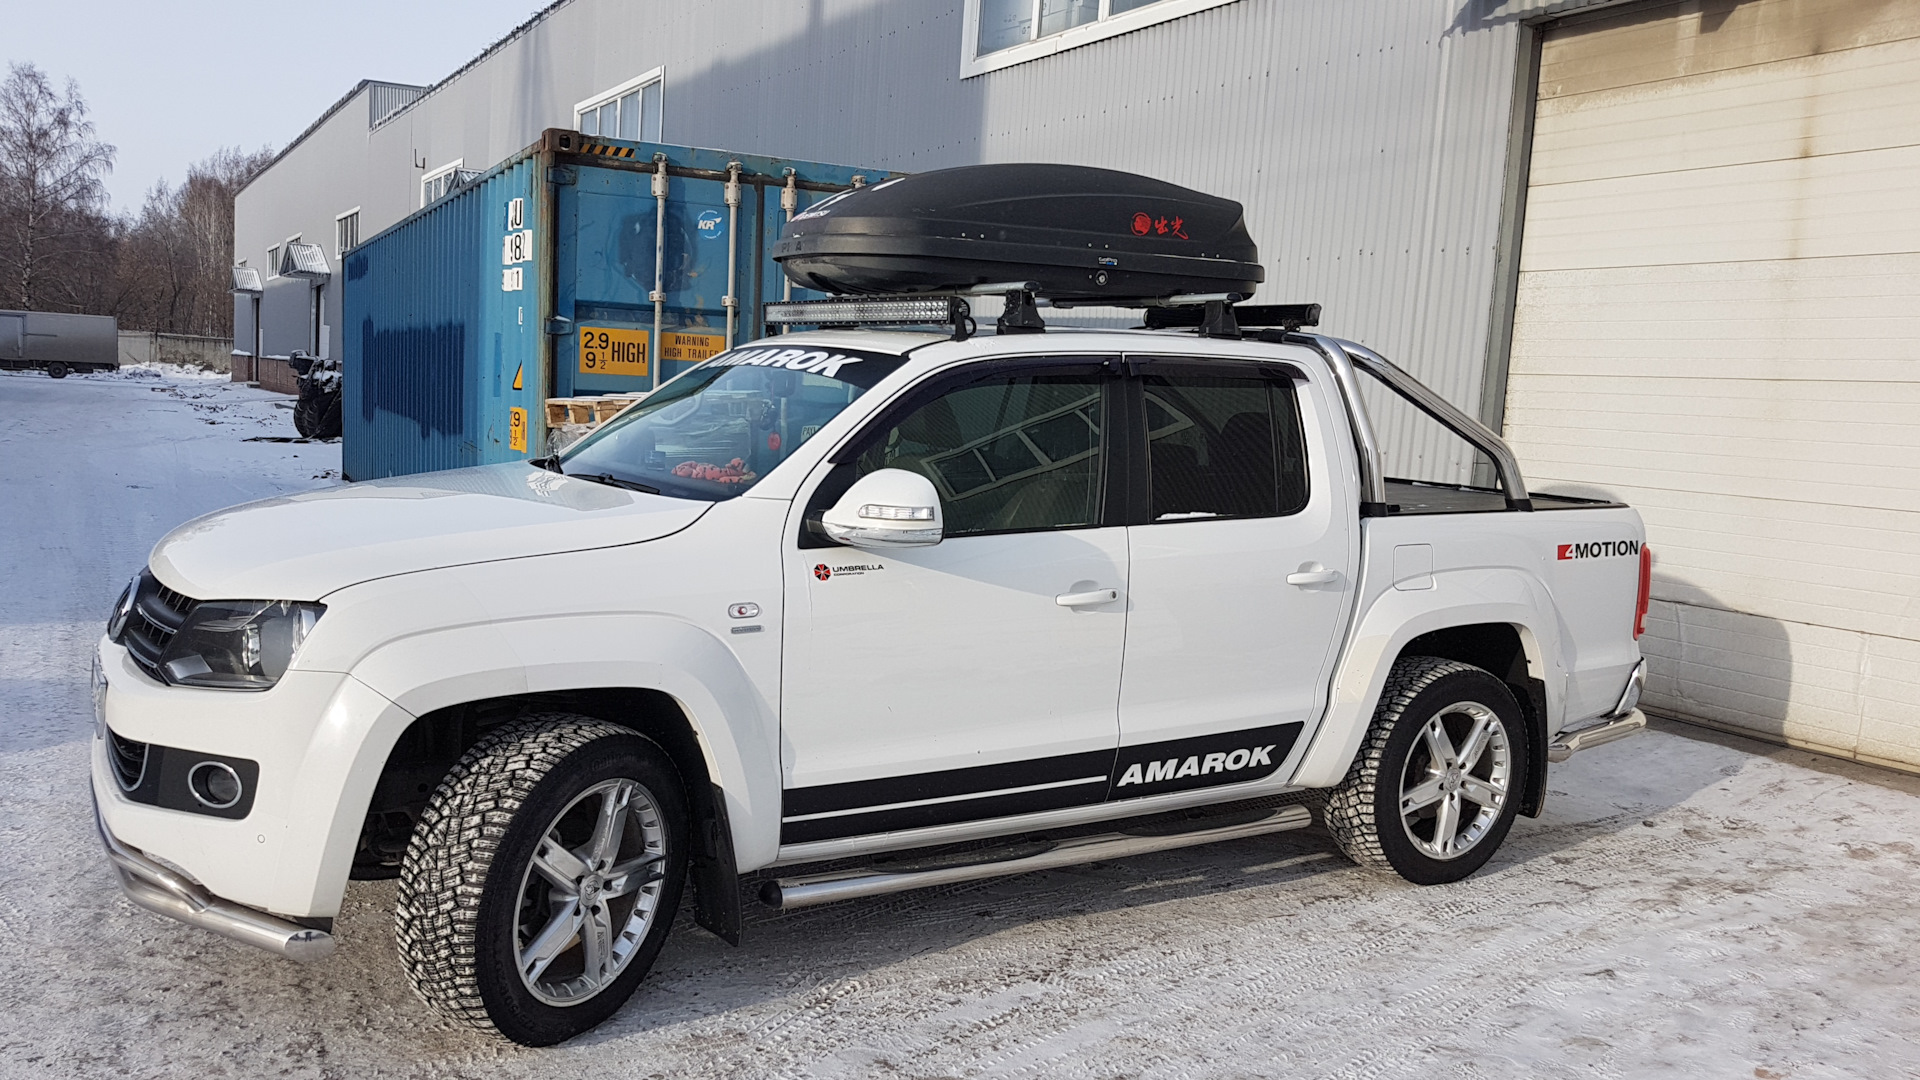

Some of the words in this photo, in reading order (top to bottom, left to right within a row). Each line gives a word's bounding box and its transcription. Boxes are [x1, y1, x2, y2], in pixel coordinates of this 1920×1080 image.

[698, 220, 716, 230] KR
[584, 331, 609, 349] 2.9
[675, 334, 710, 347] WARNING
[612, 341, 646, 363] HIGH
[664, 347, 682, 358] HIGH
[699, 349, 863, 378] AMAROK
[1557, 540, 1639, 560] 4MOTION
[832, 564, 884, 572] UMBRELLA
[1117, 744, 1277, 787] AMAROK
